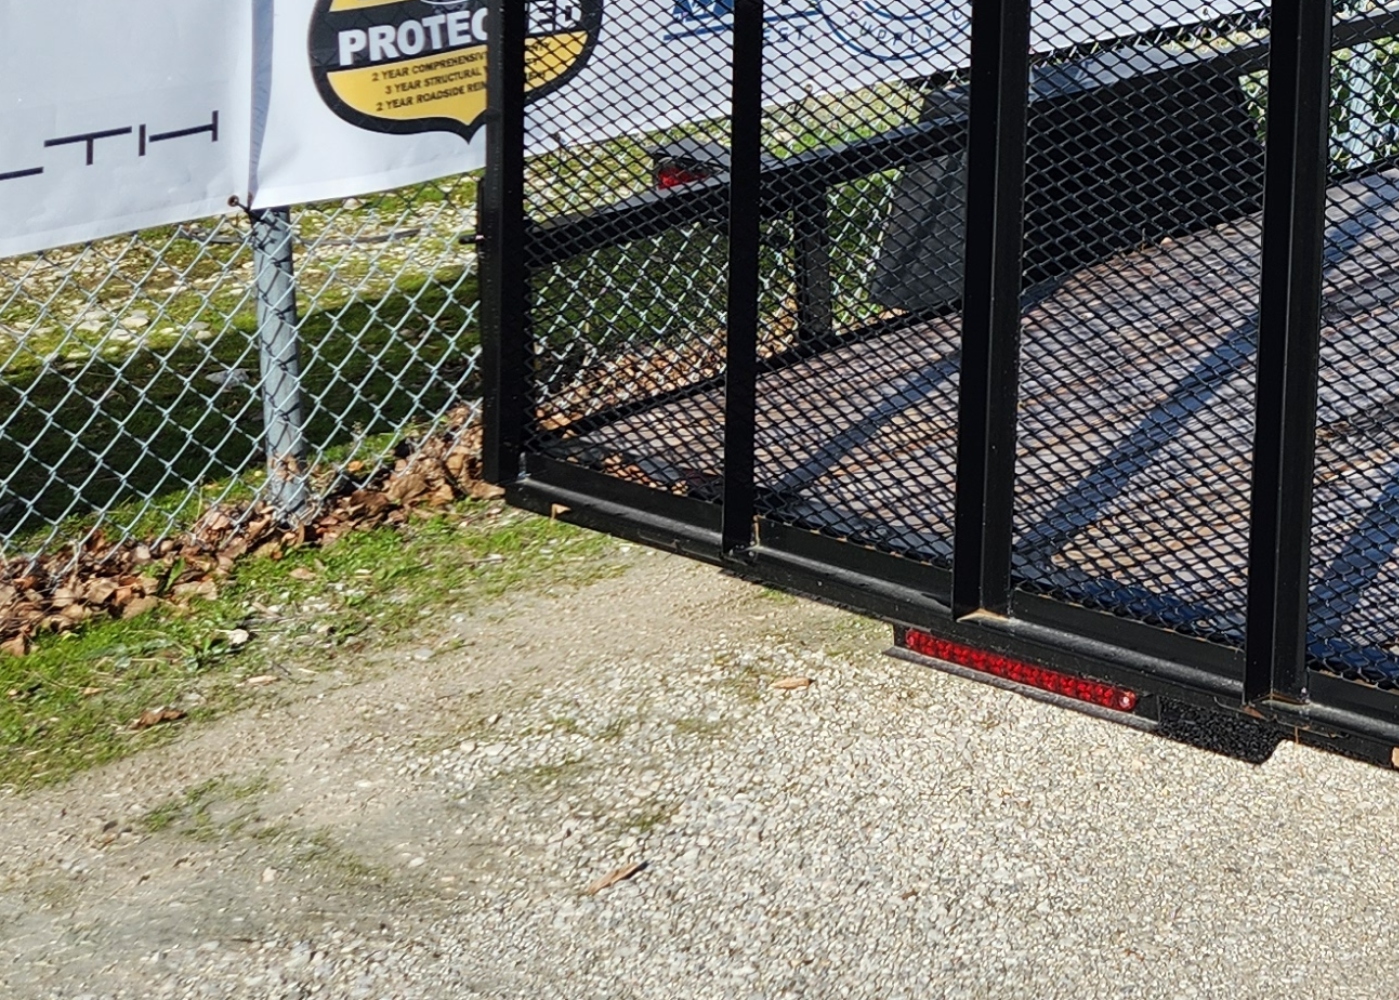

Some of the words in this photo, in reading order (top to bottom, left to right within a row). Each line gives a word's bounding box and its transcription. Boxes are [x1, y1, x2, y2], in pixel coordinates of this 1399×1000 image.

[371, 72, 379, 82] 2
[381, 67, 409, 80] YEAR
[385, 85, 392, 94] 3
[394, 80, 421, 92] YEAR
[424, 67, 482, 88] STRUCTURAL
[376, 102, 384, 112] 2
[386, 96, 414, 110] YEAR
[416, 85, 466, 104] ROADSIDE
